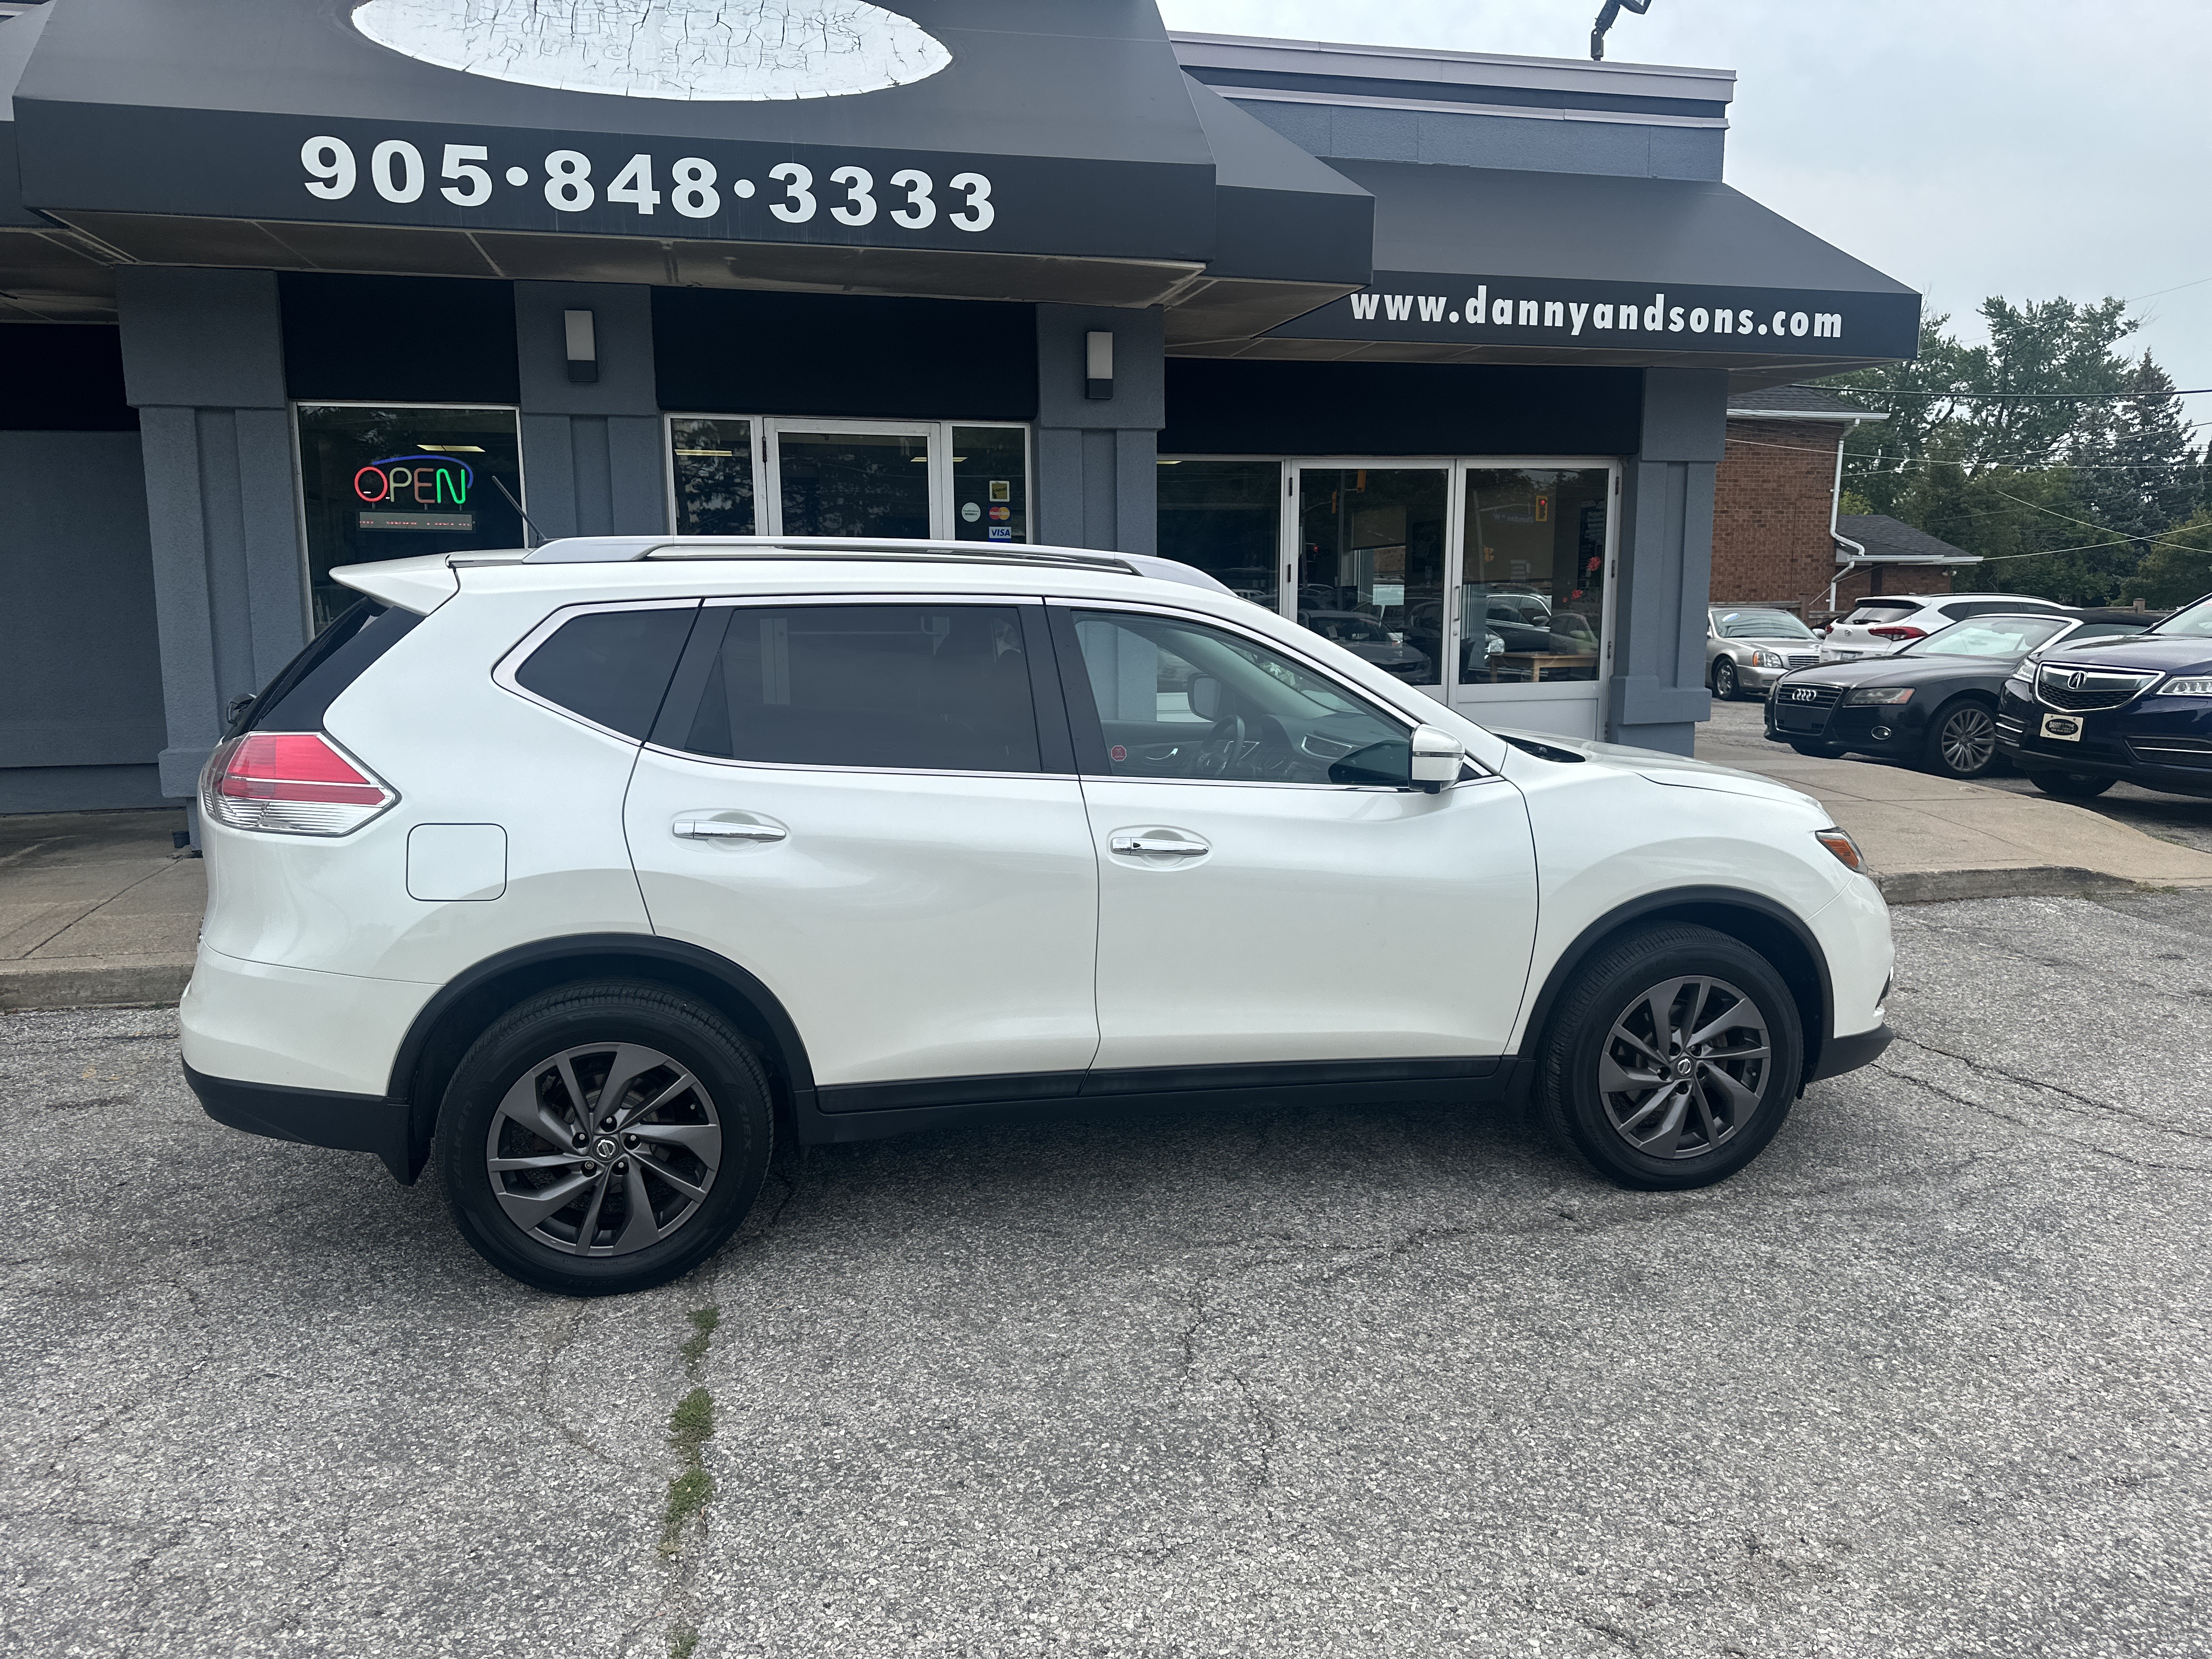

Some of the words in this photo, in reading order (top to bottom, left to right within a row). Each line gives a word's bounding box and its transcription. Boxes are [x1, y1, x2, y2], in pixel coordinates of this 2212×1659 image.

[1350, 285, 1842, 338] www.dannyandsons.com
[354, 466, 466, 504] OPEN
[737, 1101, 752, 1152] ZIEX
